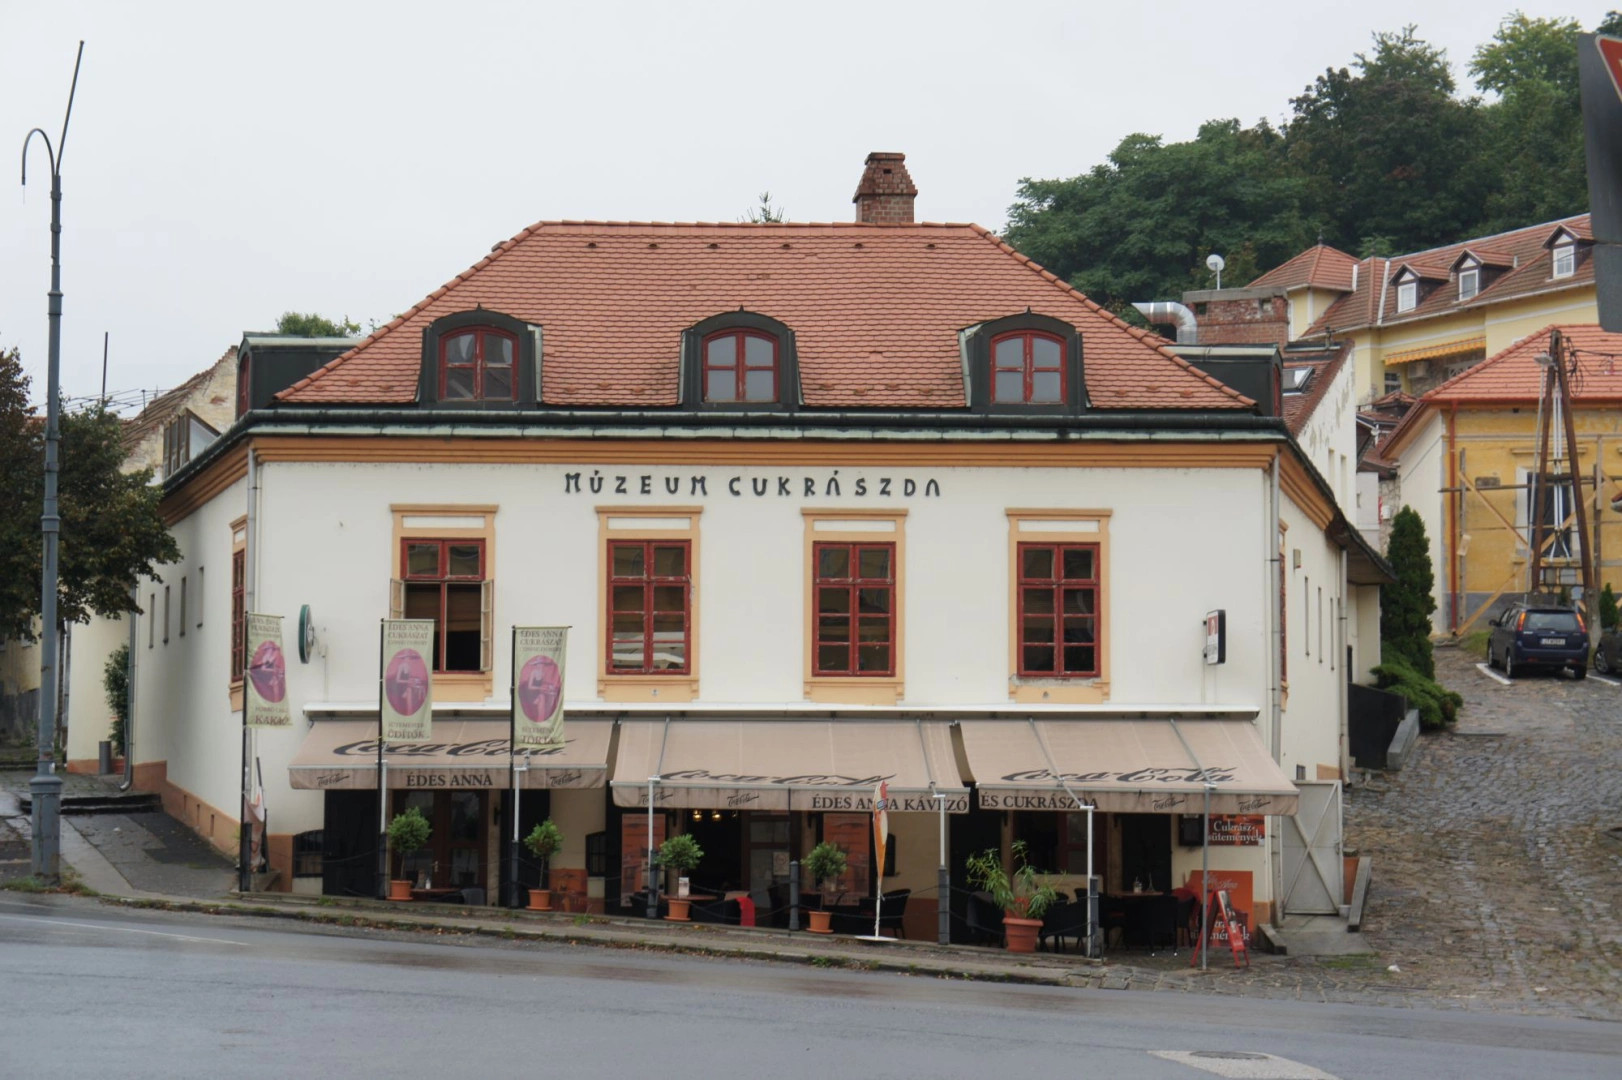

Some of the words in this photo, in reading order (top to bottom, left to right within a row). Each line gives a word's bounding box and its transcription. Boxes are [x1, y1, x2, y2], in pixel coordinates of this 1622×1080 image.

[565, 470, 708, 496] MÚZEUM
[728, 470, 941, 498] CUKRÁSZDA
[406, 771, 446, 787] ÉDES
[450, 773, 493, 787] ANNA
[1001, 767, 1241, 782] Coca-Cola
[812, 793, 852, 809] ÉDES
[981, 792, 999, 808] ÉS
[1213, 818, 1255, 832] Cukrász-
